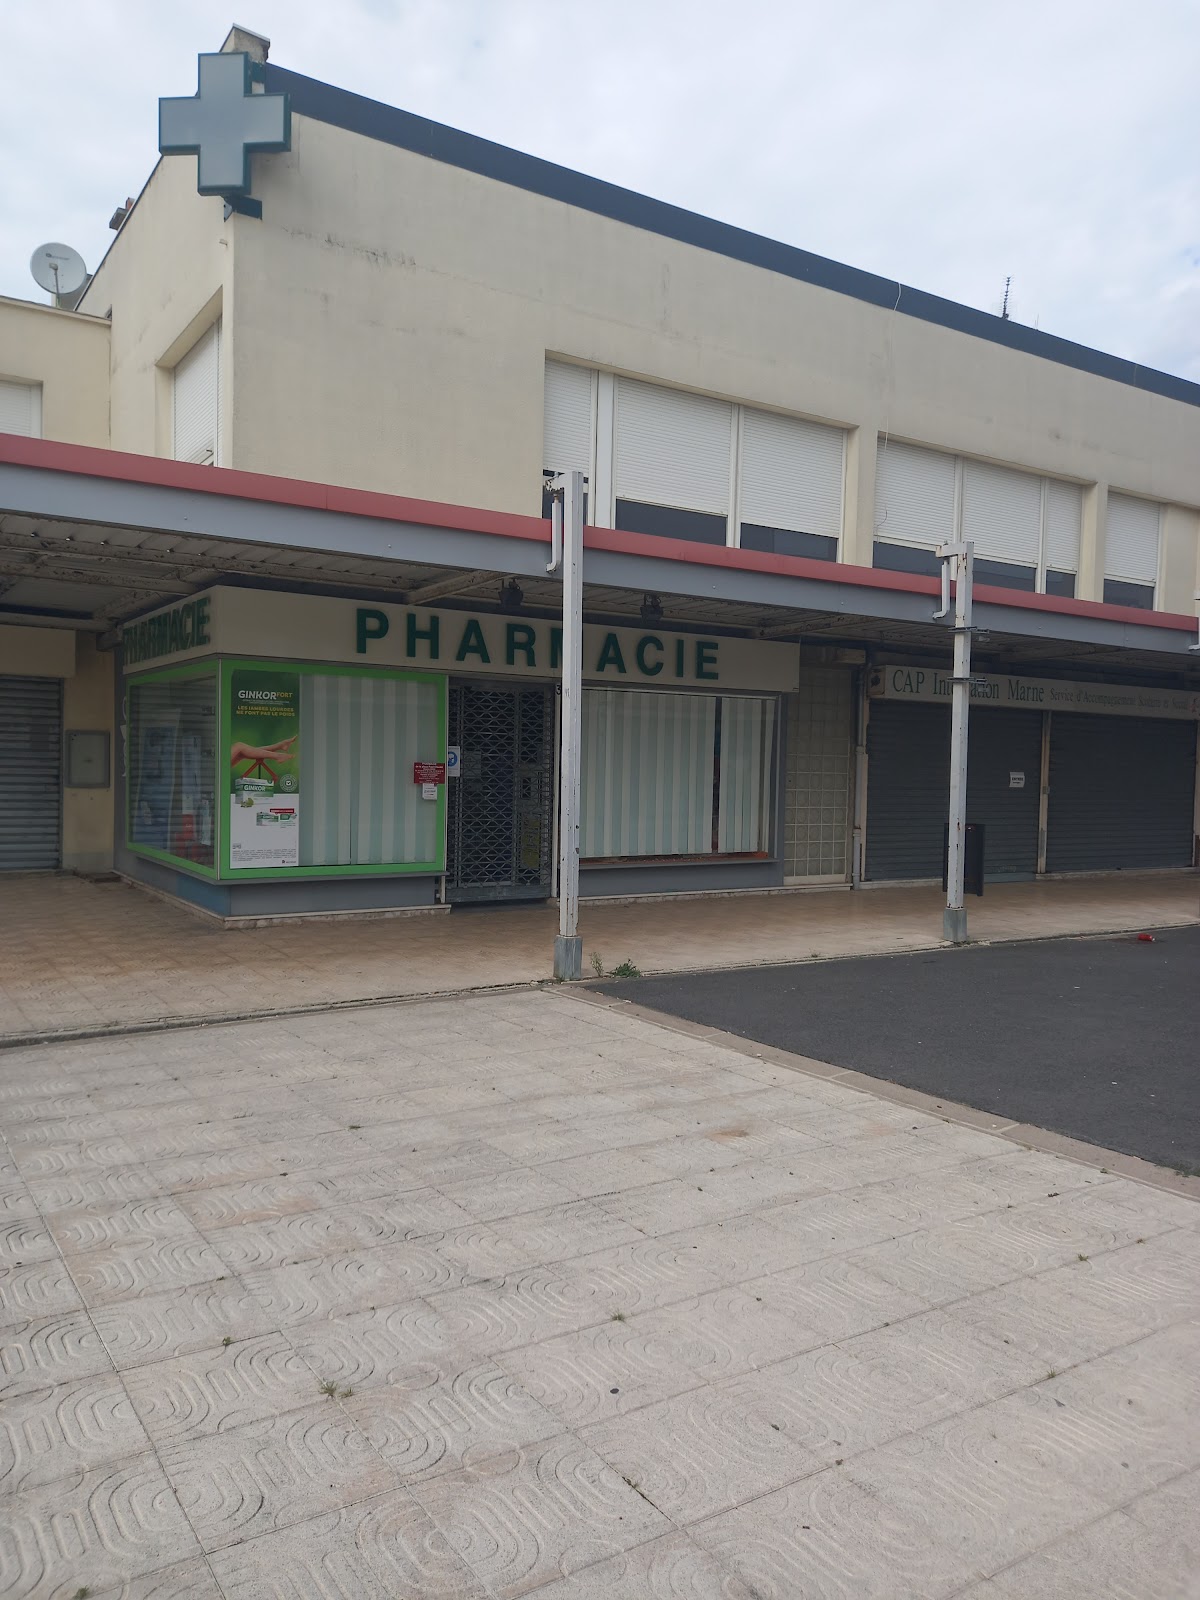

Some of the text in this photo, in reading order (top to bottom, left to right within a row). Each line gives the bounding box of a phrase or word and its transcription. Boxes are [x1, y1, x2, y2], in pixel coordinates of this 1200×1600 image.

[238, 690, 277, 700] GINKOR
[892, 669, 925, 694] CAP
[1008, 678, 1045, 703] Marne
[1050, 688, 1074, 702] Service
